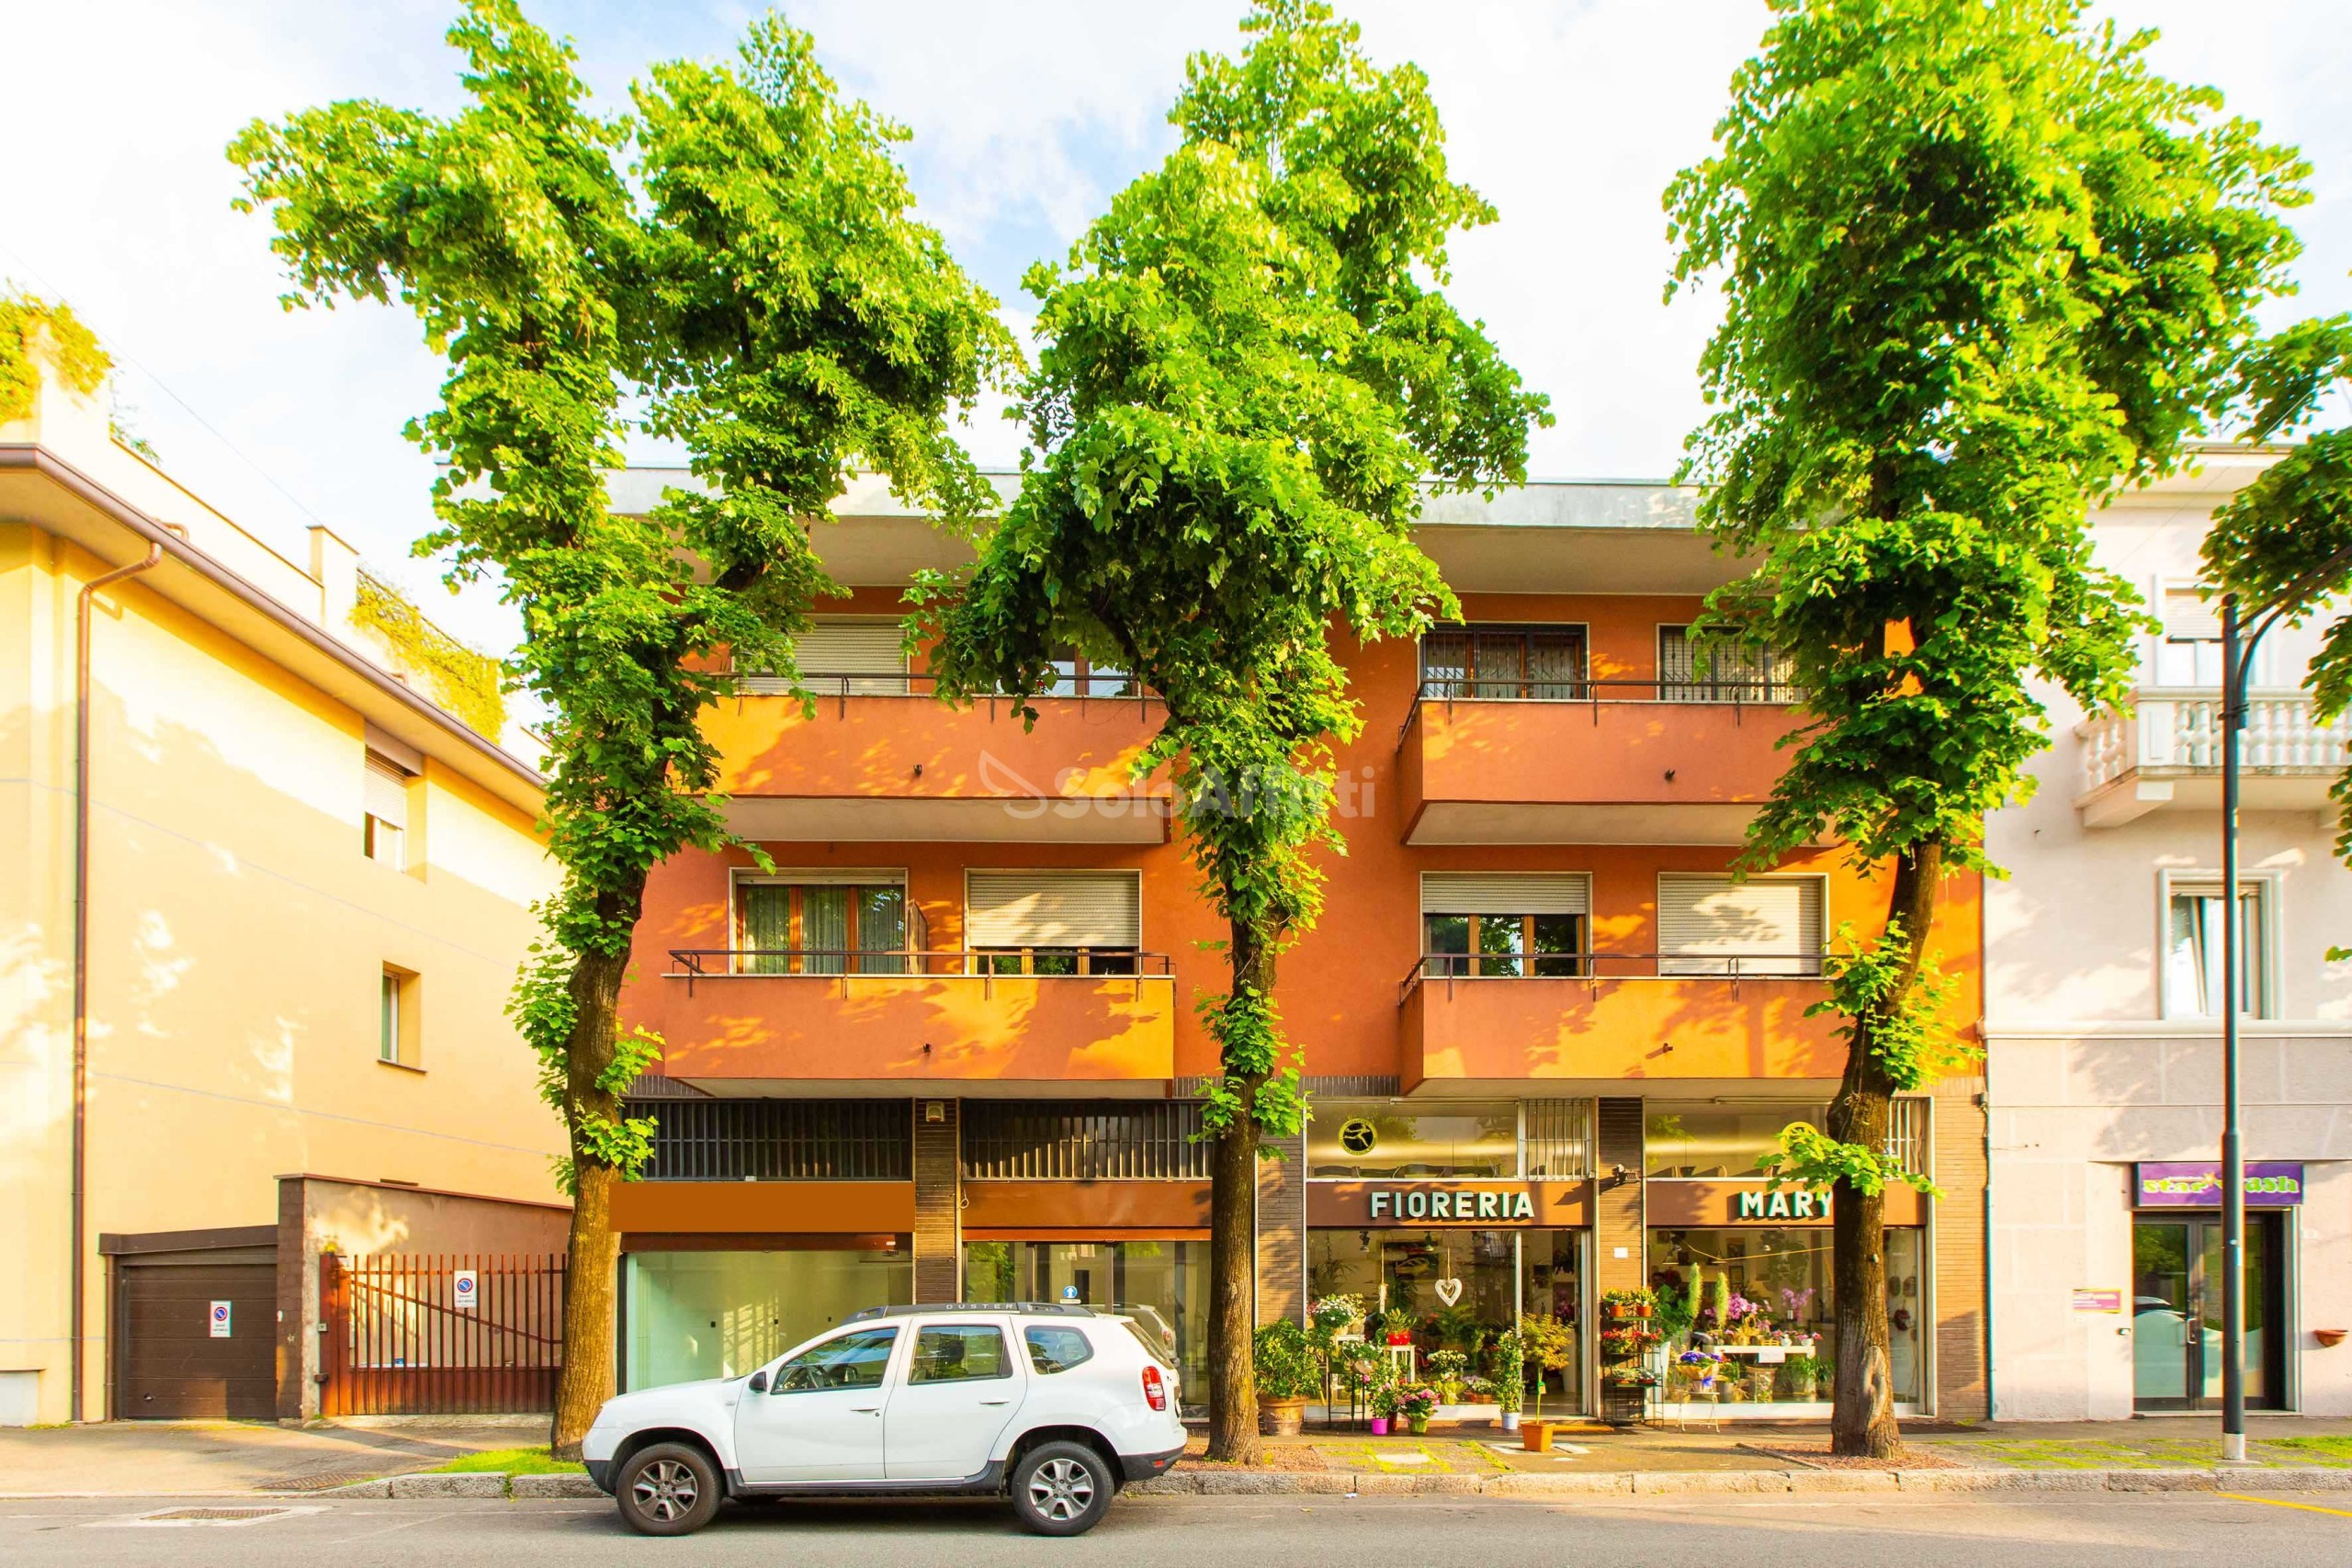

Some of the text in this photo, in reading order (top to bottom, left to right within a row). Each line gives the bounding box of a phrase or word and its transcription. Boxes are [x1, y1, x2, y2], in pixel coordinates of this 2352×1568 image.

[2215, 1176, 2300, 1193] ash
[1371, 1190, 1834, 1218] FIORERIA MARY
